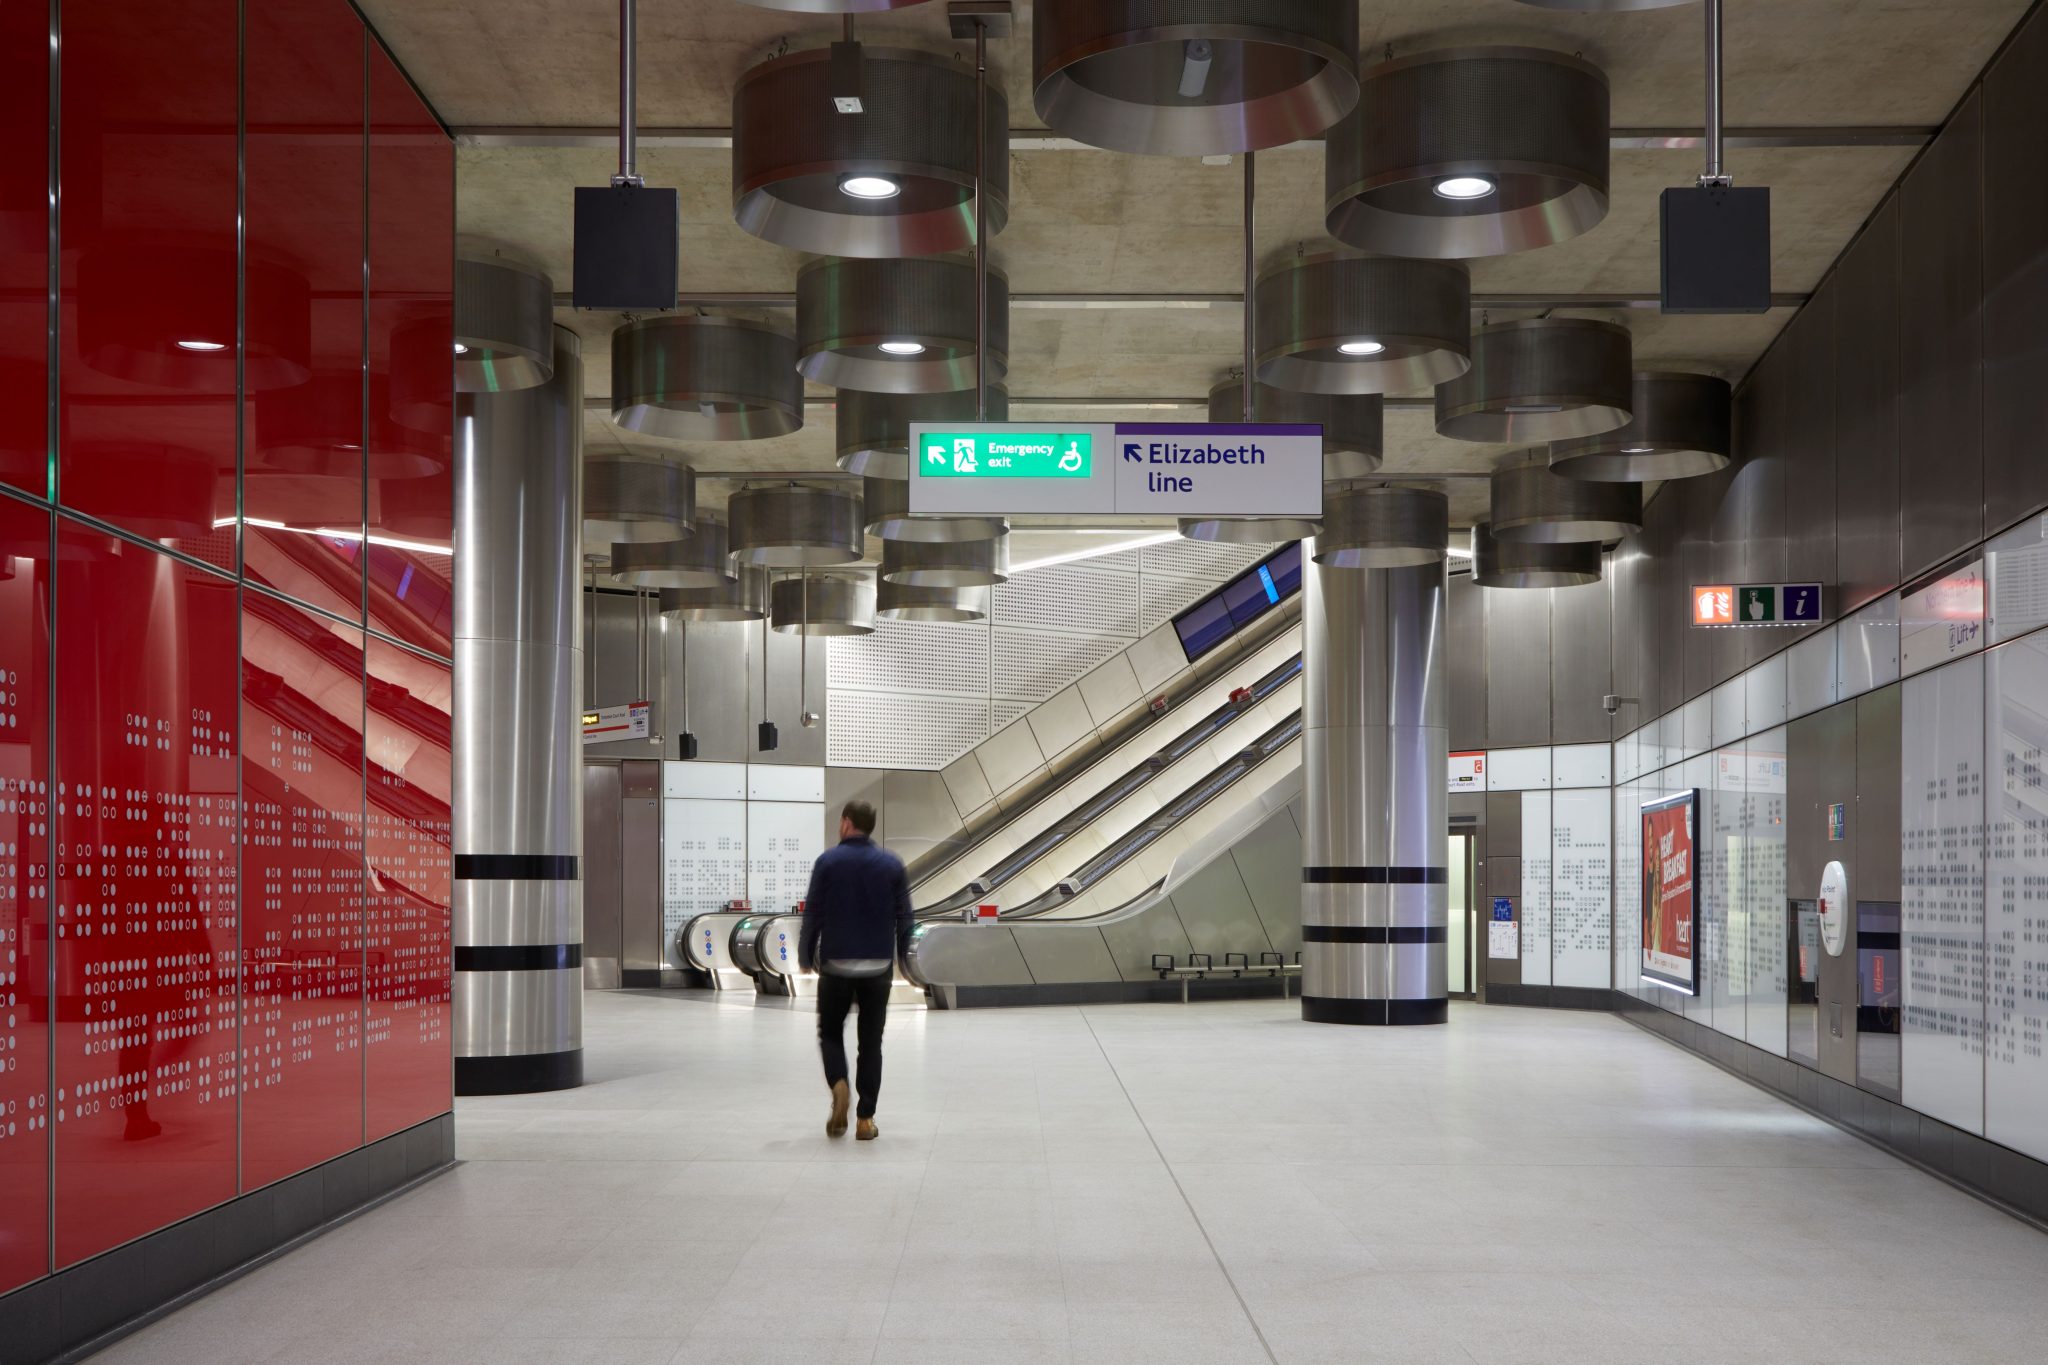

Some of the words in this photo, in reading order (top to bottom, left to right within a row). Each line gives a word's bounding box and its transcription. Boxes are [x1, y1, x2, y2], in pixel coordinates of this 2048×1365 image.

[988, 442, 1054, 456] Emergency
[1149, 443, 1265, 464] Elizabeth
[988, 456, 1012, 467] exit
[1148, 471, 1193, 492] line
[1957, 624, 1969, 645] Lift
[1660, 828, 1674, 860] HEART
[1663, 849, 1687, 884] BREAKFAST
[1676, 912, 1691, 943] heart
